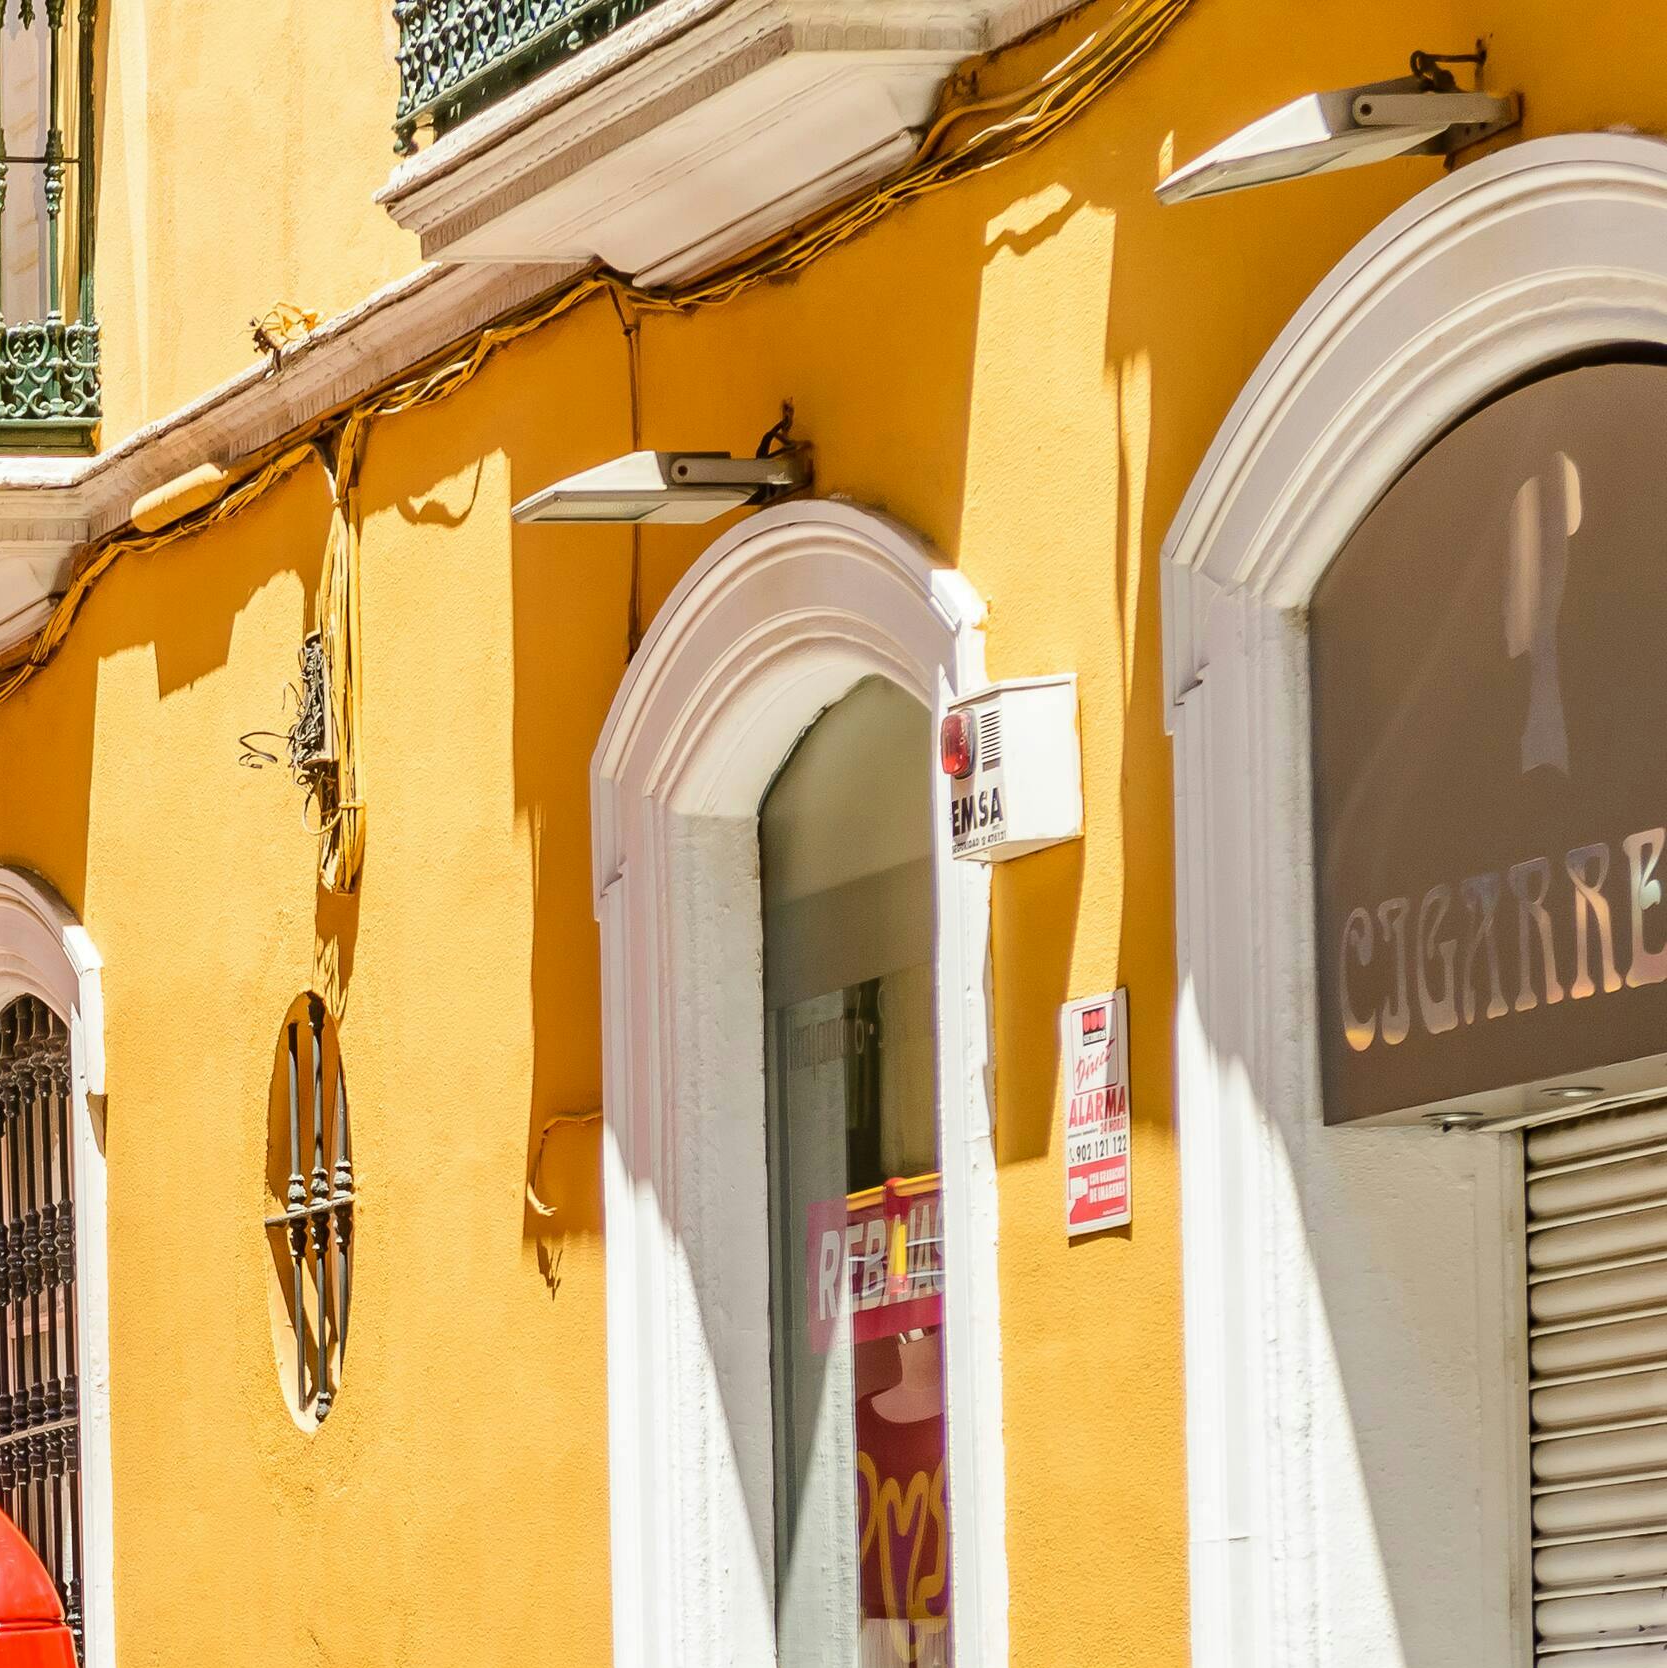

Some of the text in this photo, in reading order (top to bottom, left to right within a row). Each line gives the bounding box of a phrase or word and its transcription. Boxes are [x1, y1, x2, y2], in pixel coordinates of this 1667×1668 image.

[1069, 1085, 1127, 1129] ALARMA
[1076, 1134, 1127, 1162] 902 121 122
